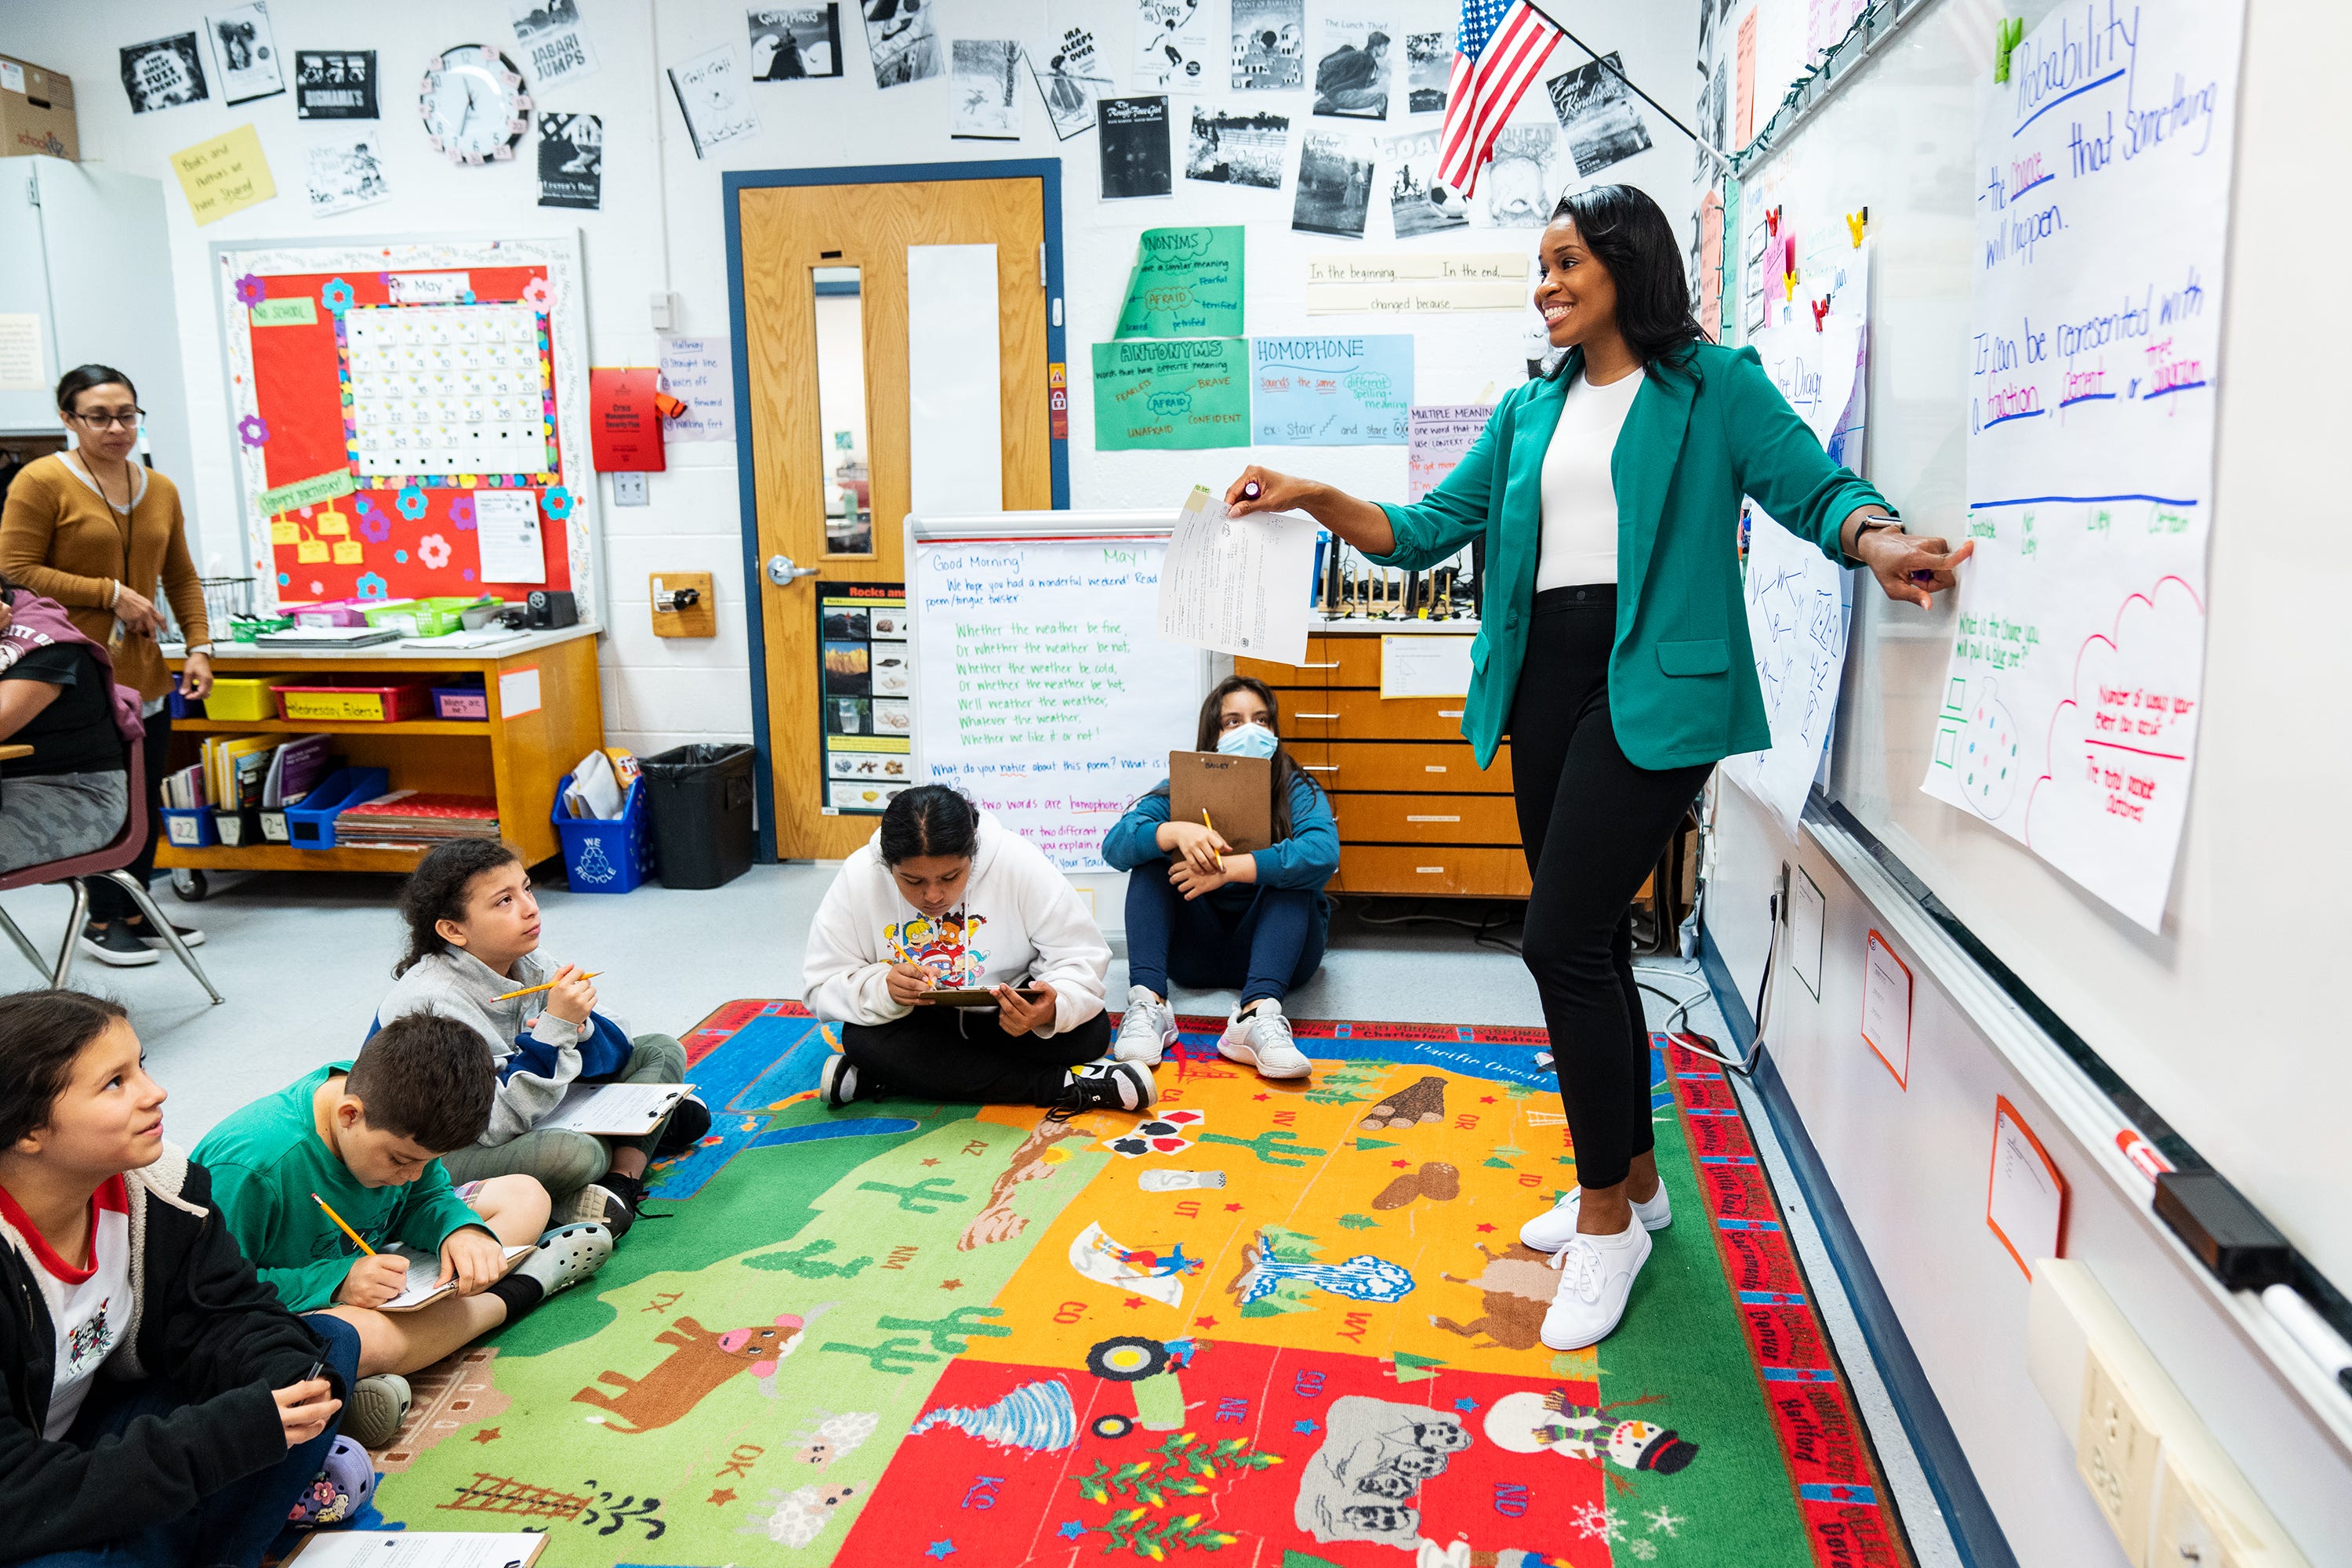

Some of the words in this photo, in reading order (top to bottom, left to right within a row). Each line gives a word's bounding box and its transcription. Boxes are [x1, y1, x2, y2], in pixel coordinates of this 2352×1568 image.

[1064, 27, 1081, 41] IRA
[1325, 19, 1339, 29] The
[1341, 20, 1364, 30] Lunch
[1367, 22, 1388, 31] Thief
[532, 33, 579, 64] JABARI
[1061, 32, 1094, 54] SLEEPS
[1069, 45, 1094, 62] OVER
[535, 52, 586, 81] JUMPS
[1548, 66, 1584, 100] Each
[1560, 85, 1619, 119] Kindness
[2067, 111, 2114, 179] that
[2123, 73, 2218, 161] something
[1986, 218, 2007, 270] will
[2011, 205, 2070, 267] happen.
[1193, 260, 1229, 272] meaning
[1309, 263, 1323, 279] In
[1328, 264, 1345, 279] the
[1350, 264, 1398, 281] beginning,
[1443, 262, 1456, 277] In
[1461, 263, 1478, 277] the
[1481, 265, 1501, 278] end,
[415, 279, 442, 295] May
[1149, 292, 1187, 305] AFRAID
[1202, 301, 1238, 310] terrified
[1371, 297, 1410, 311] changed
[1416, 296, 1450, 310] because
[1173, 318, 1206, 332] petrified
[1974, 332, 1989, 376] It
[1992, 336, 2019, 373] can
[2024, 317, 2048, 364] be
[2056, 283, 2153, 372] represented
[2160, 265, 2205, 325] with
[672, 340, 704, 352] Hallway
[1120, 340, 1224, 363] ANTONYMS
[1258, 339, 1364, 361] HOMOPHONE
[702, 359, 718, 368] line
[1119, 368, 1134, 378] that
[1138, 366, 1153, 375] have
[1157, 362, 1189, 372] OPPOSITE
[1192, 361, 1229, 373] meaning
[1198, 377, 1231, 389] BRAVE
[1297, 376, 1311, 388] the
[1315, 379, 1336, 389] same
[1347, 376, 1388, 389] different
[1774, 358, 1791, 400] Tree
[1152, 397, 1186, 408] AFRAID
[1365, 400, 1407, 415] meaning
[1188, 413, 1242, 425] CONFIDENT
[1411, 408, 1450, 420] MULTIPLE
[1455, 408, 1494, 419] MEANIN
[1127, 425, 1174, 438] UNAFRAID
[1341, 424, 1358, 436] and
[1367, 424, 1388, 436] stare
[1414, 427, 1427, 436] one
[1431, 425, 1450, 434] word
[1453, 424, 1470, 434] that
[933, 554, 963, 572] Good
[970, 552, 1025, 574] Morning!
[1104, 548, 1136, 567] May
[1143, 550, 1148, 561] 1
[849, 586, 886, 597] Rocks
[947, 578, 961, 592] We
[966, 577, 984, 593] hope
[988, 579, 1004, 591] you
[1007, 575, 1025, 589] had
[1039, 575, 1082, 589] wonderful
[1088, 574, 1130, 587] weekend!
[1135, 572, 1158, 585] Read
[925, 593, 984, 613] poem/tongue
[956, 622, 1003, 639] Whether
[1011, 622, 1029, 636] the
[1035, 621, 1079, 635] weather
[1087, 621, 1098, 634] be
[956, 644, 970, 658] Or
[975, 642, 1018, 655] whether
[1024, 641, 1041, 654] the
[1045, 641, 1089, 654] weather
[1097, 641, 1109, 654] be
[959, 715, 1007, 730] Whatever
[1013, 715, 1033, 726] the
[960, 732, 1004, 746] Whether
[1010, 732, 1024, 743] we
[1027, 730, 1046, 742] like
[1062, 731, 1073, 742] or
[931, 761, 957, 777] What
[964, 761, 975, 775] do
[978, 765, 996, 778] you
[1000, 763, 1028, 775] notice
[1033, 760, 1057, 772] about
[1063, 760, 1081, 772] this
[1087, 756, 1117, 774] poem?
[1121, 757, 1148, 769] What
[982, 798, 1002, 811] two
[1006, 797, 1038, 810] words
[1044, 799, 1062, 811] are
[265, 818, 285, 835] 24
[583, 837, 601, 848] WE
[574, 865, 617, 884] RECYCLE
[1363, 1030, 1446, 1040] Charleston
[1414, 1043, 1480, 1065] Pacific
[1484, 1061, 1548, 1083] Ocean
[1273, 1110, 1295, 1127] NV
[1454, 1113, 1480, 1131] OR
[960, 1139, 989, 1157] AZ
[1519, 1173, 1542, 1188] ID
[1174, 1200, 1202, 1219] UT
[880, 1244, 920, 1270] NM
[1729, 1232, 1762, 1290] Sacramento
[641, 1290, 684, 1313] TX
[1052, 1301, 1088, 1325] CO
[1337, 1311, 1373, 1344] WY
[1748, 1311, 1780, 1361] Denver
[1294, 1368, 1327, 1399] SD
[1215, 1396, 1248, 1425] NE
[1778, 1399, 1824, 1465] Hartford
[715, 1443, 764, 1479] OK
[962, 1475, 1005, 1509] KS
[1494, 1483, 1528, 1518] ND
